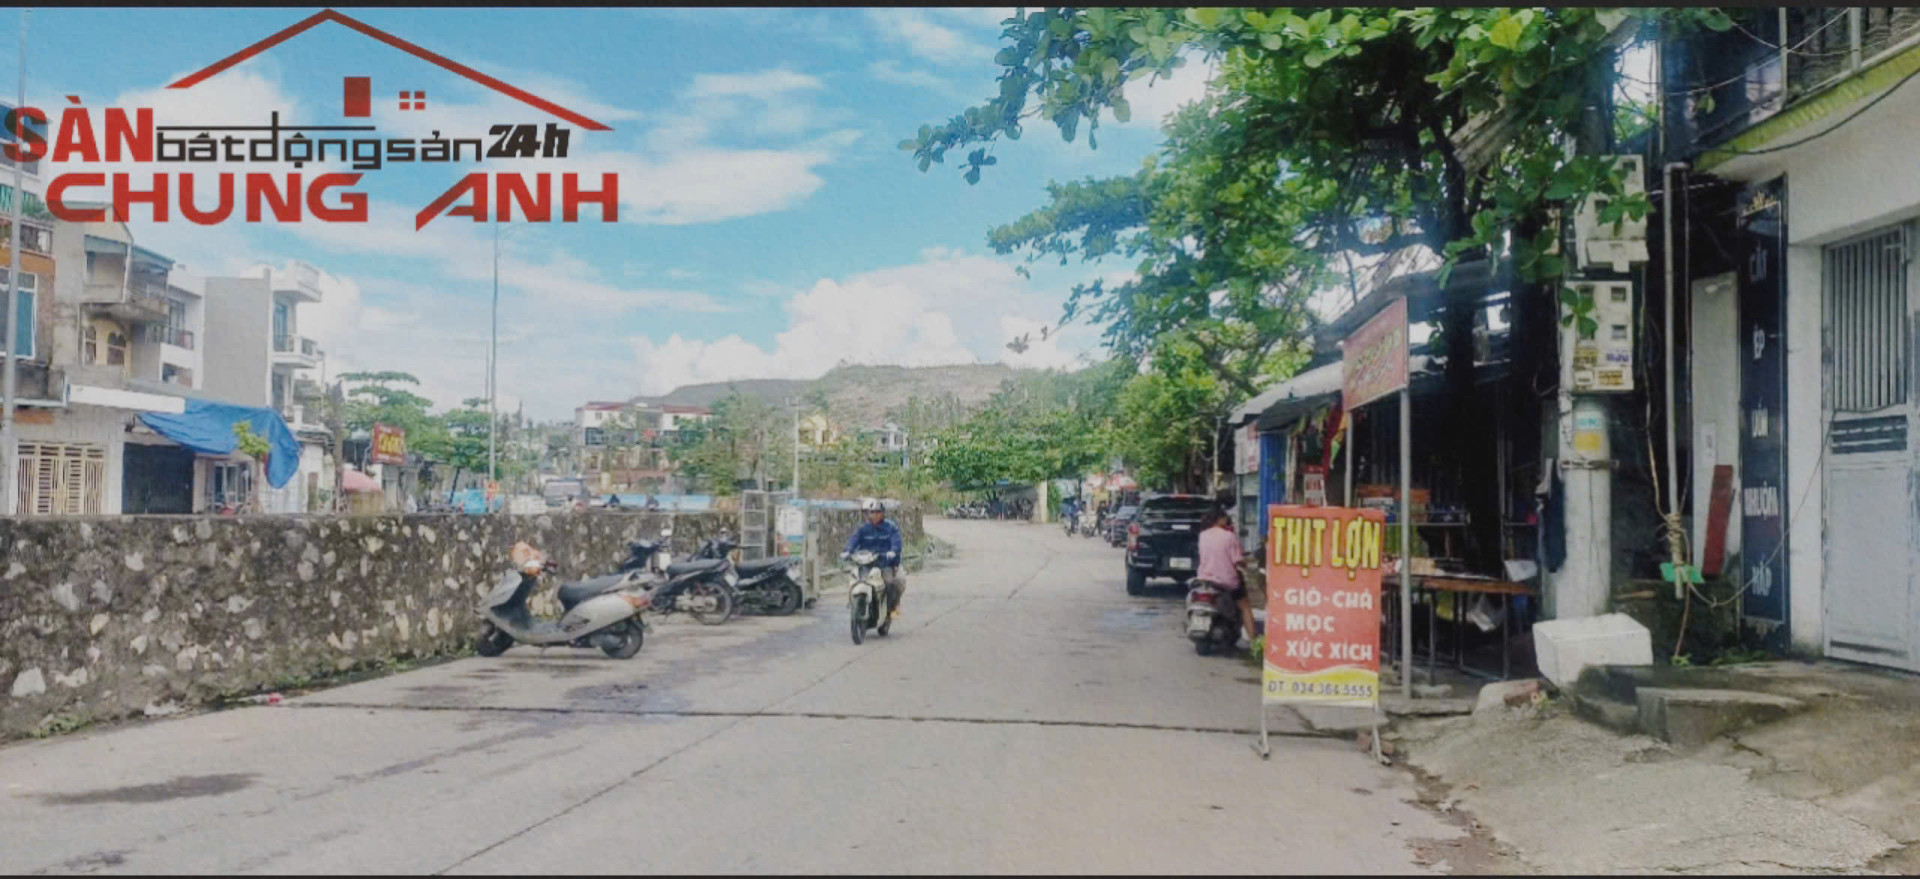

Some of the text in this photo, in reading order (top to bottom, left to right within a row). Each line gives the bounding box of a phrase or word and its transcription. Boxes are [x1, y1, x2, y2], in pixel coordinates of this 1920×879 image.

[1273, 514, 1381, 580] THỊT LỢN
[1285, 613, 1336, 636] MỌC
[1285, 637, 1374, 661] XÚC XÍCH
